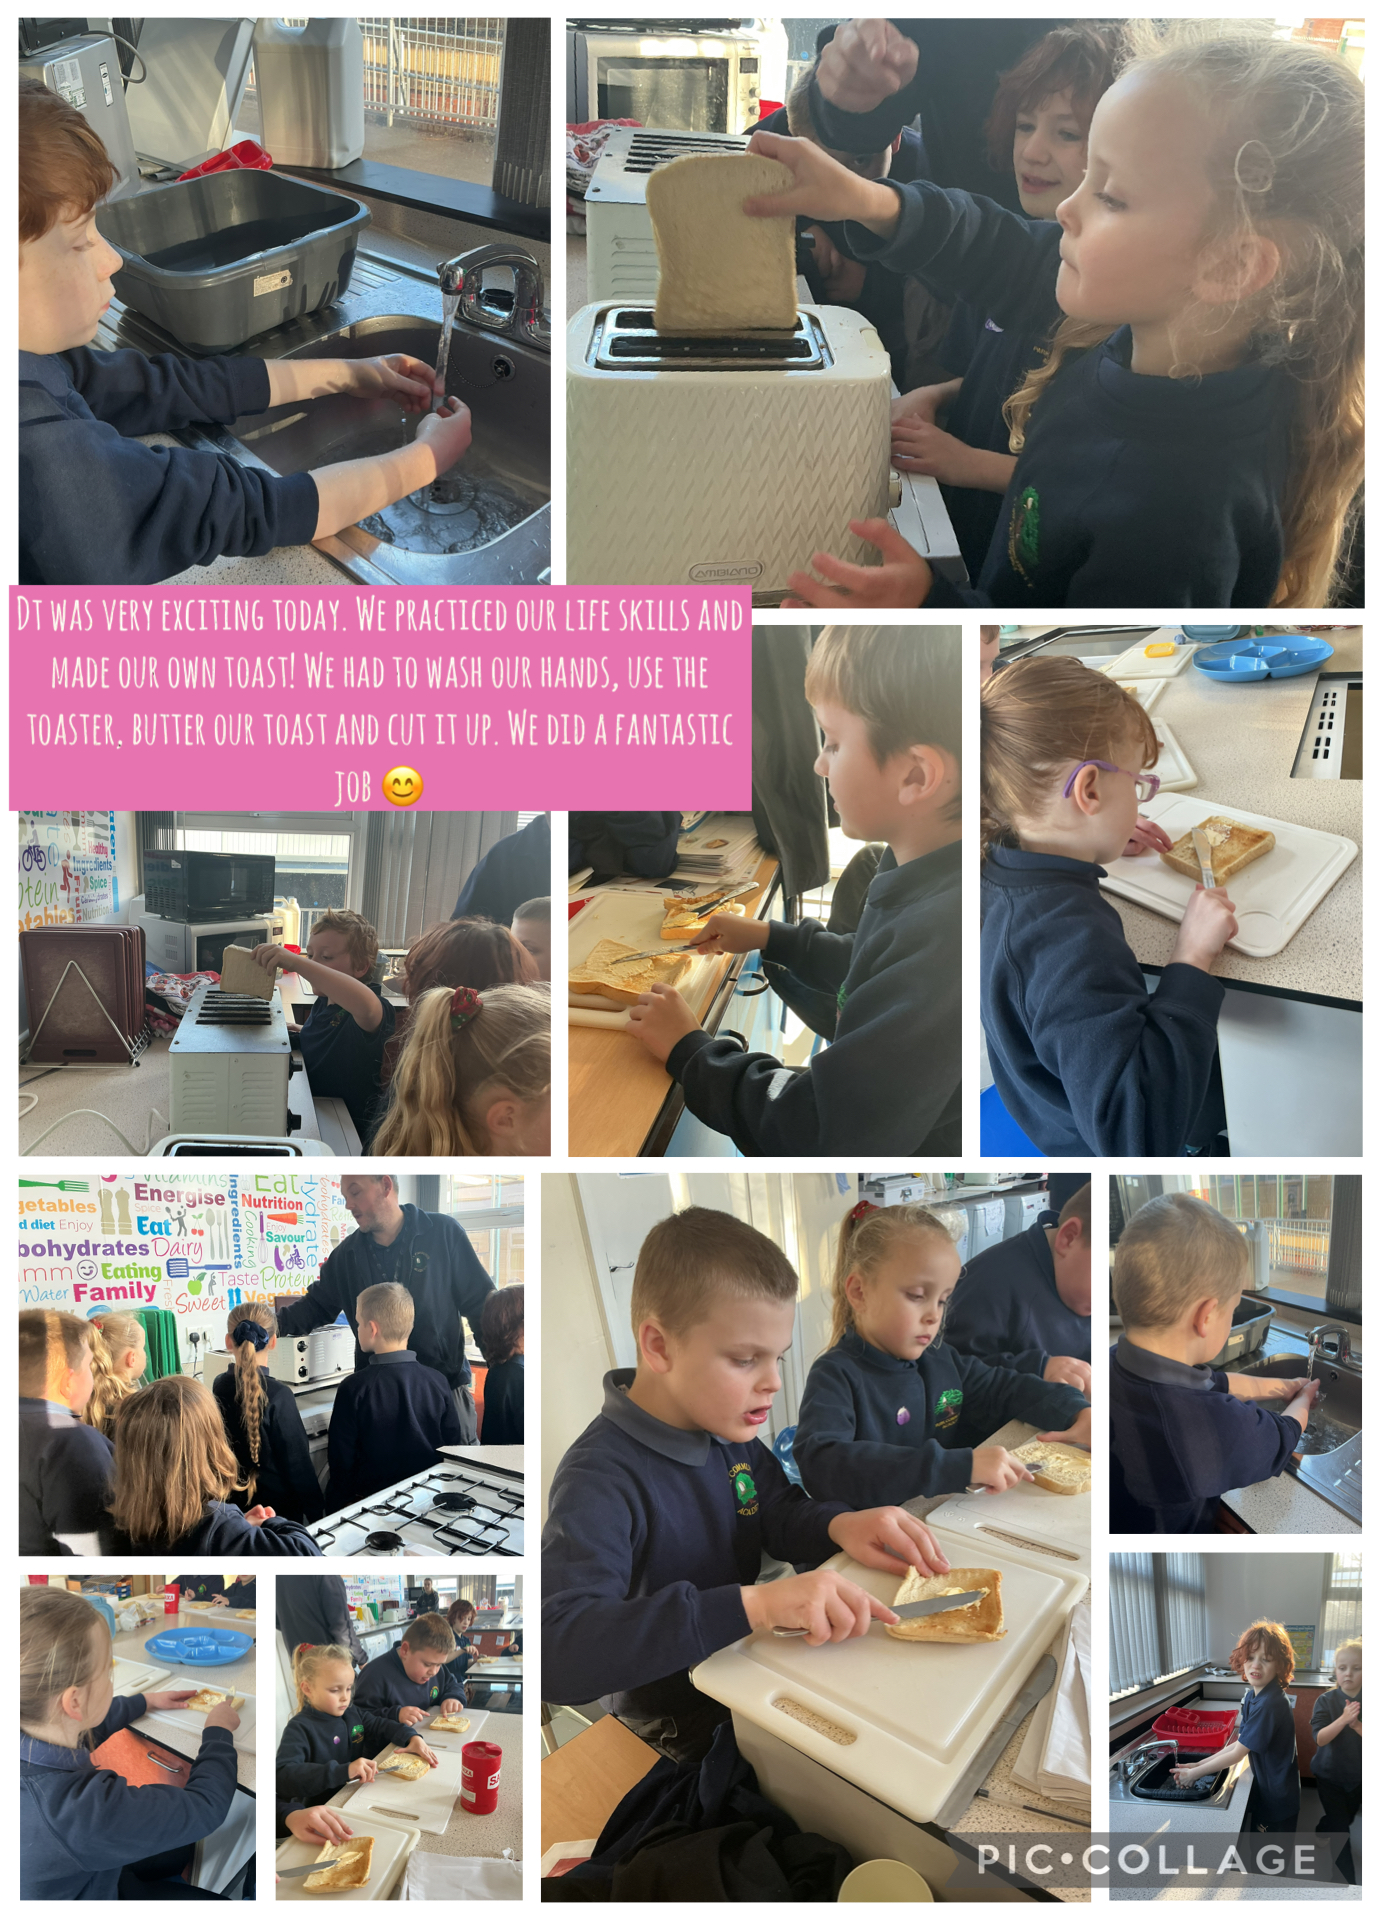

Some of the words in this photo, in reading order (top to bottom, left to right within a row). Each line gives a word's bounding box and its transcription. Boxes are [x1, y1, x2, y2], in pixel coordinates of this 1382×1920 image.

[694, 566, 759, 578] AMBIANO
[88, 841, 109, 858] Healthy
[73, 856, 113, 875] Ingredients
[90, 876, 108, 892] Spice
[83, 905, 110, 921] Nutrition
[255, 1175, 300, 1194] Eat
[134, 1183, 226, 1208] Energise
[241, 1194, 303, 1211] Nutrition
[134, 1203, 161, 1214] Spice
[30, 1219, 56, 1231] diet
[59, 1219, 94, 1233] Enjoy
[137, 1216, 172, 1236] Eat
[228, 1175, 243, 1269] Ingredients
[266, 1222, 287, 1233] Enjoy
[242, 1210, 258, 1269] Cooking
[266, 1231, 306, 1243] Savour
[151, 1237, 203, 1264] Dairy
[101, 1262, 162, 1282] Eating
[218, 1271, 259, 1287] Taste
[260, 1266, 315, 1290] Protein
[19, 1285, 69, 1303] Water
[73, 1281, 157, 1303] Family
[175, 1293, 226, 1314] Sweet
